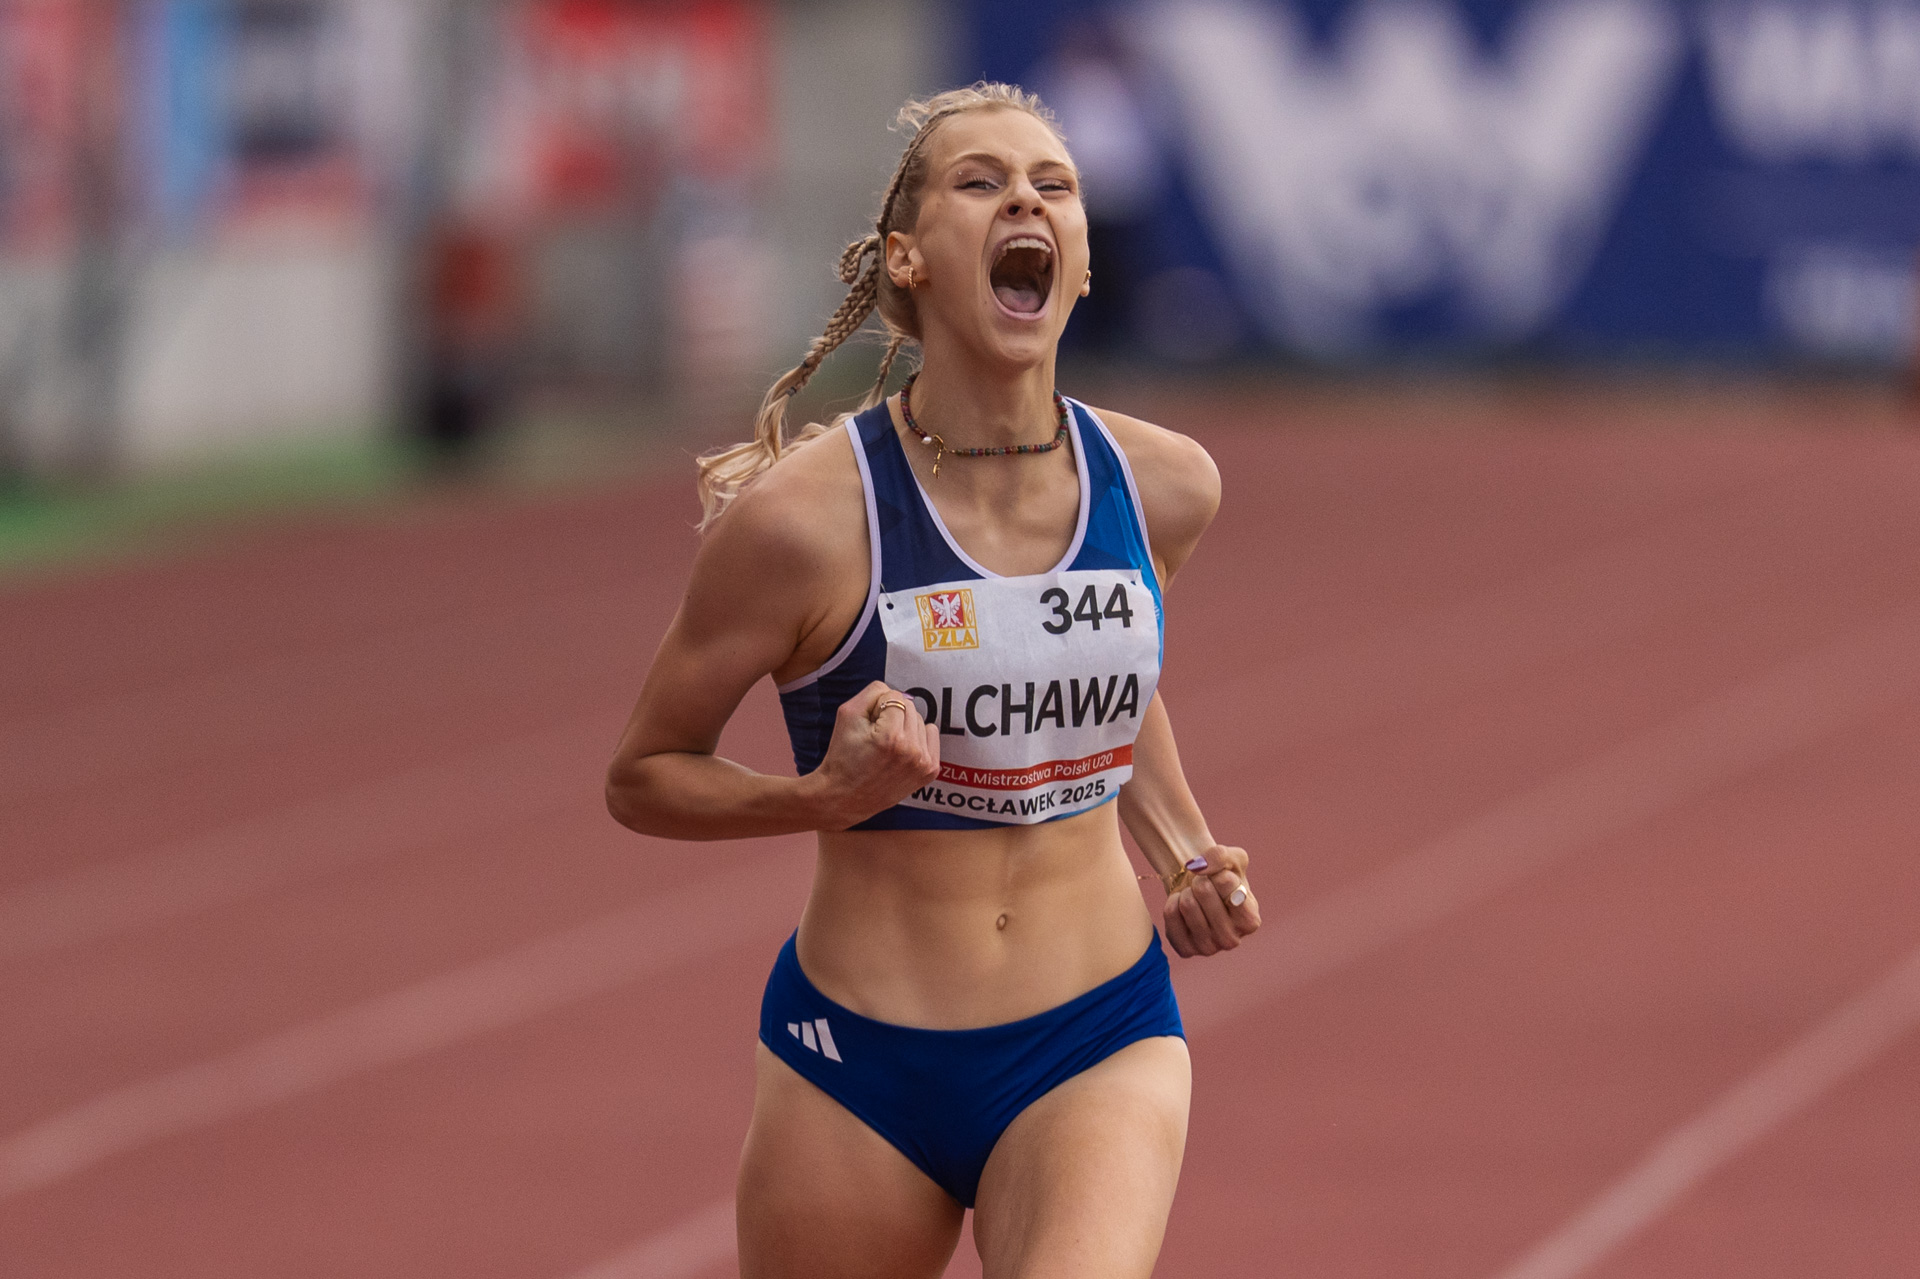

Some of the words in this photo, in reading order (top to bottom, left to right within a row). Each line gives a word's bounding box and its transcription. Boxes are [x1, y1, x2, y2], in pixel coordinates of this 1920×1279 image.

[1039, 583, 1133, 635] 344
[926, 631, 976, 649] PZLA
[973, 768, 1051, 786] Mistrzostwa
[1054, 762, 1090, 777] Polski
[1092, 752, 1113, 770] U20
[911, 786, 1057, 816] WŁOCŁAWEK
[1060, 779, 1106, 805] 2025
